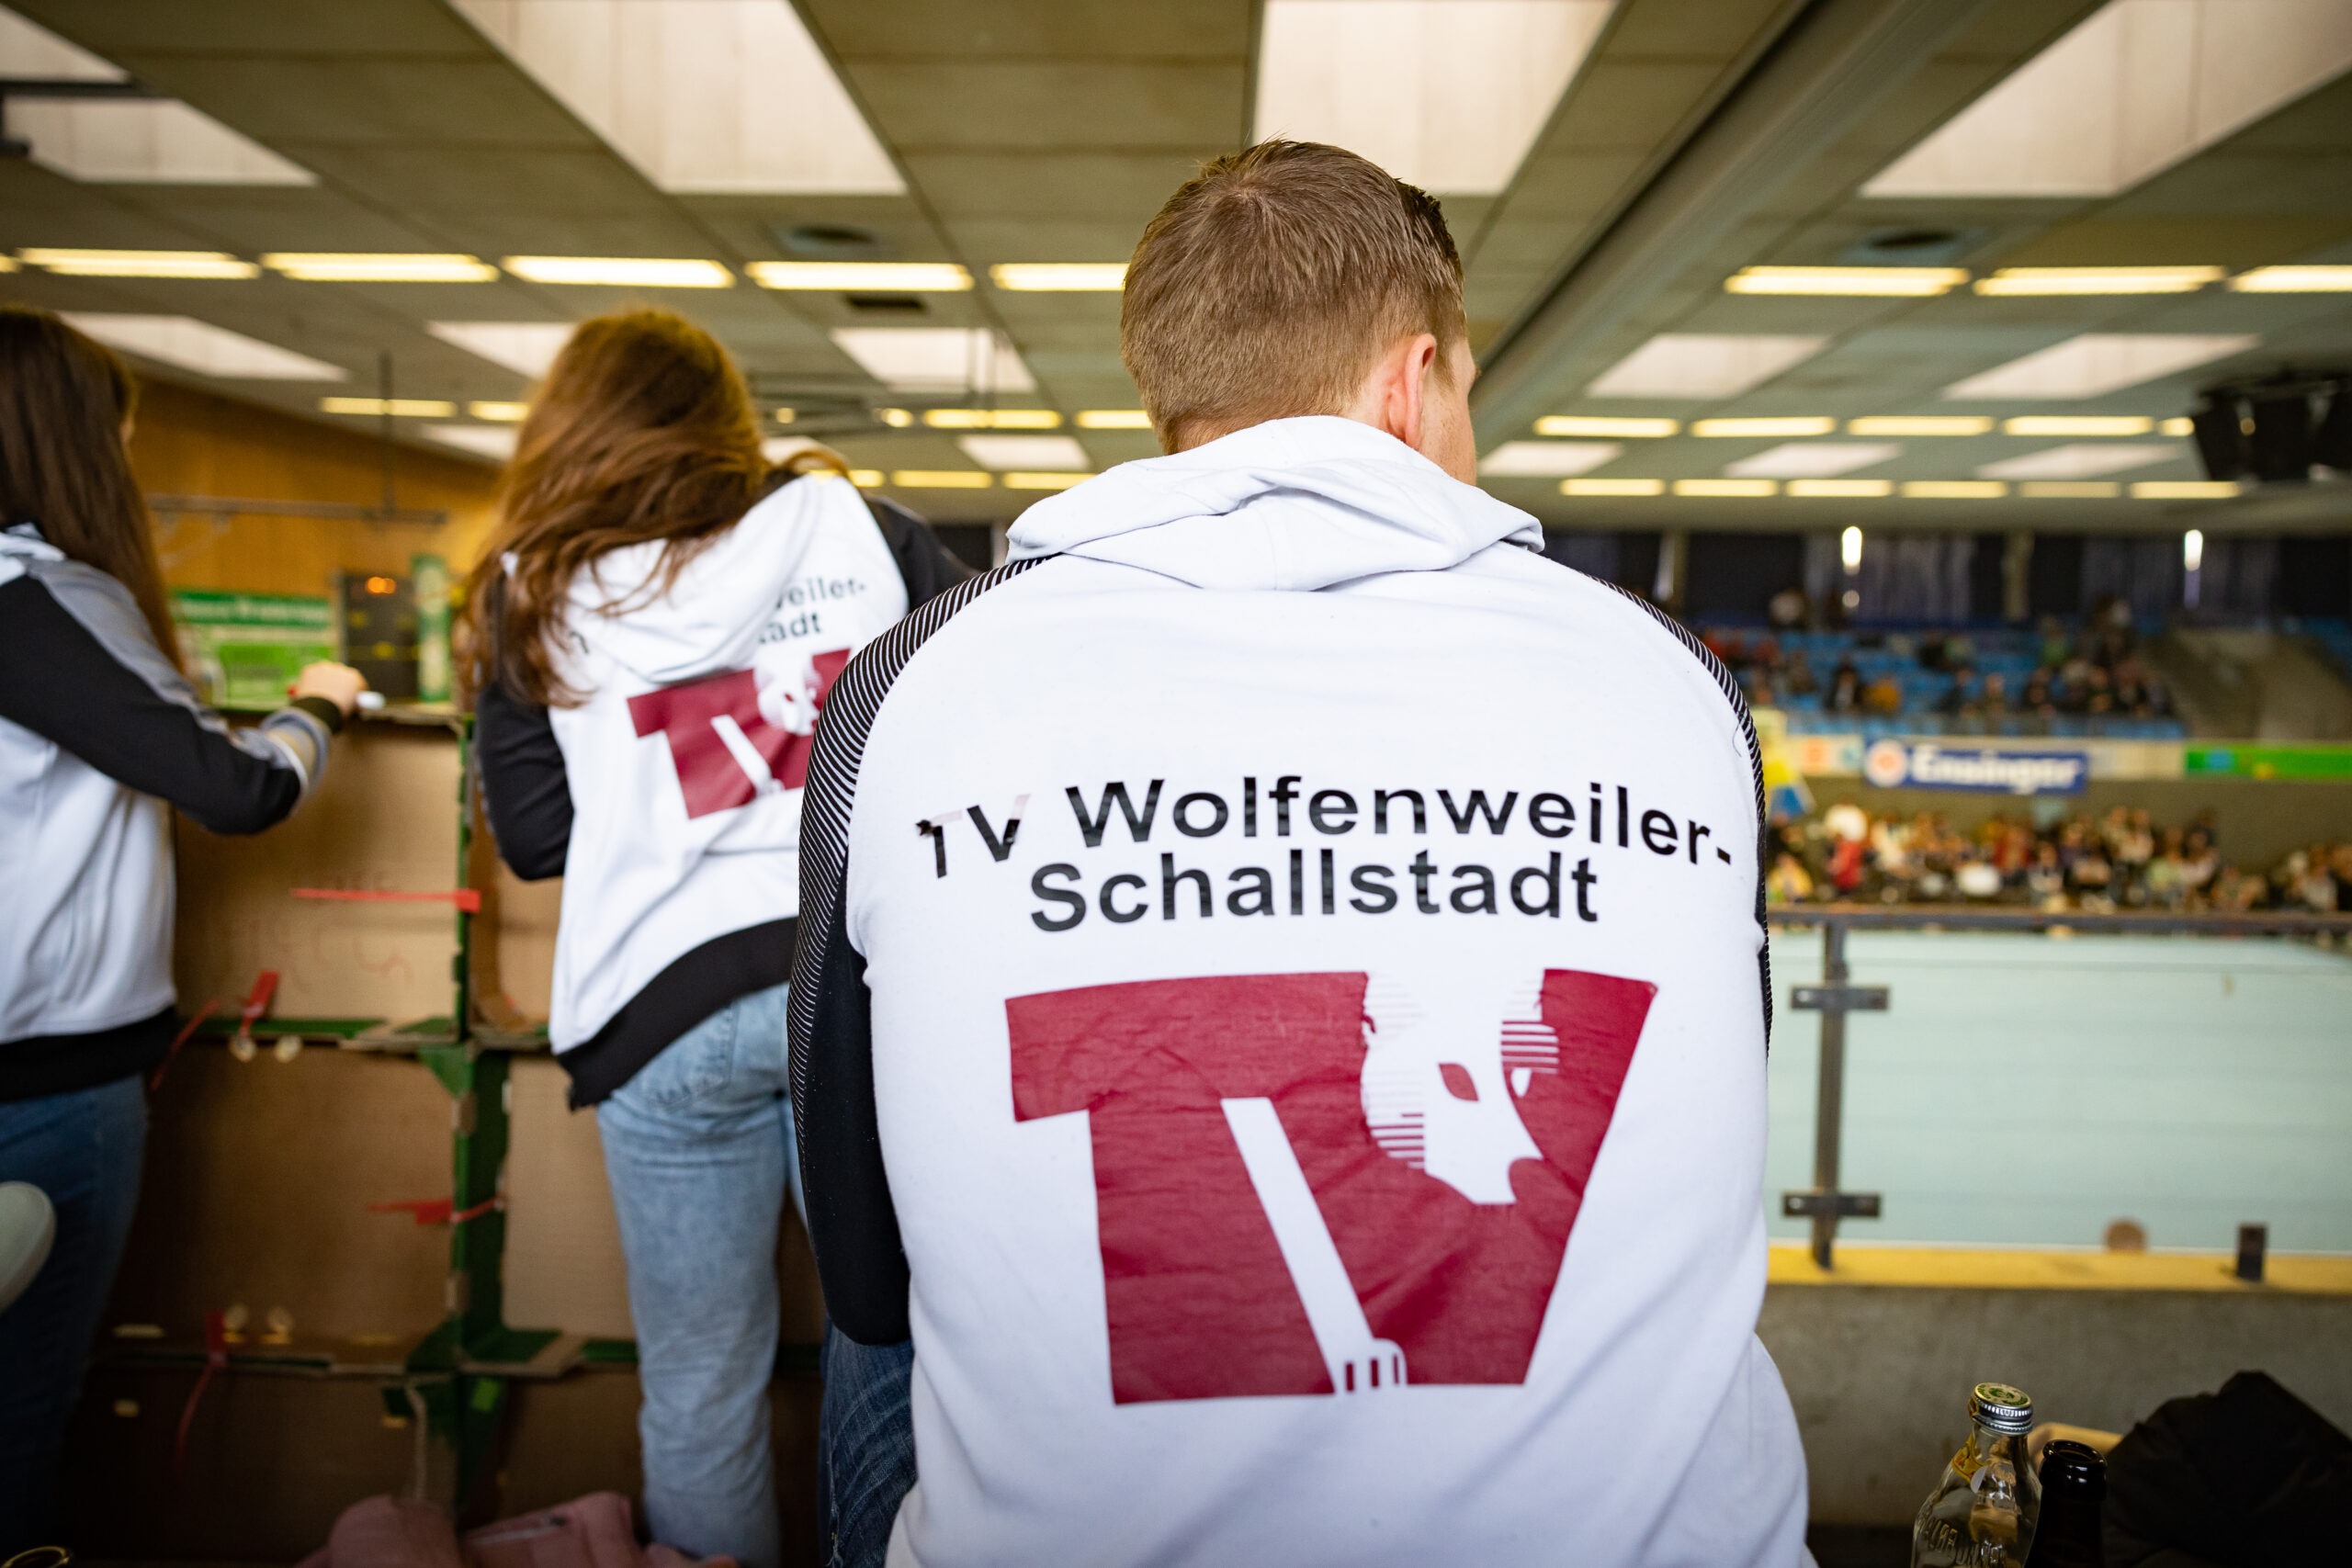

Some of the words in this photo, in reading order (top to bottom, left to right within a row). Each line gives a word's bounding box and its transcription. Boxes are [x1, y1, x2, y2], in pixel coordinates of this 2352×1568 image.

[915, 795, 1029, 879] TV
[1065, 775, 1732, 865] Wolfenweiler-
[1031, 848, 1599, 932] Schallstadt
[1005, 968, 1658, 1405] TV
